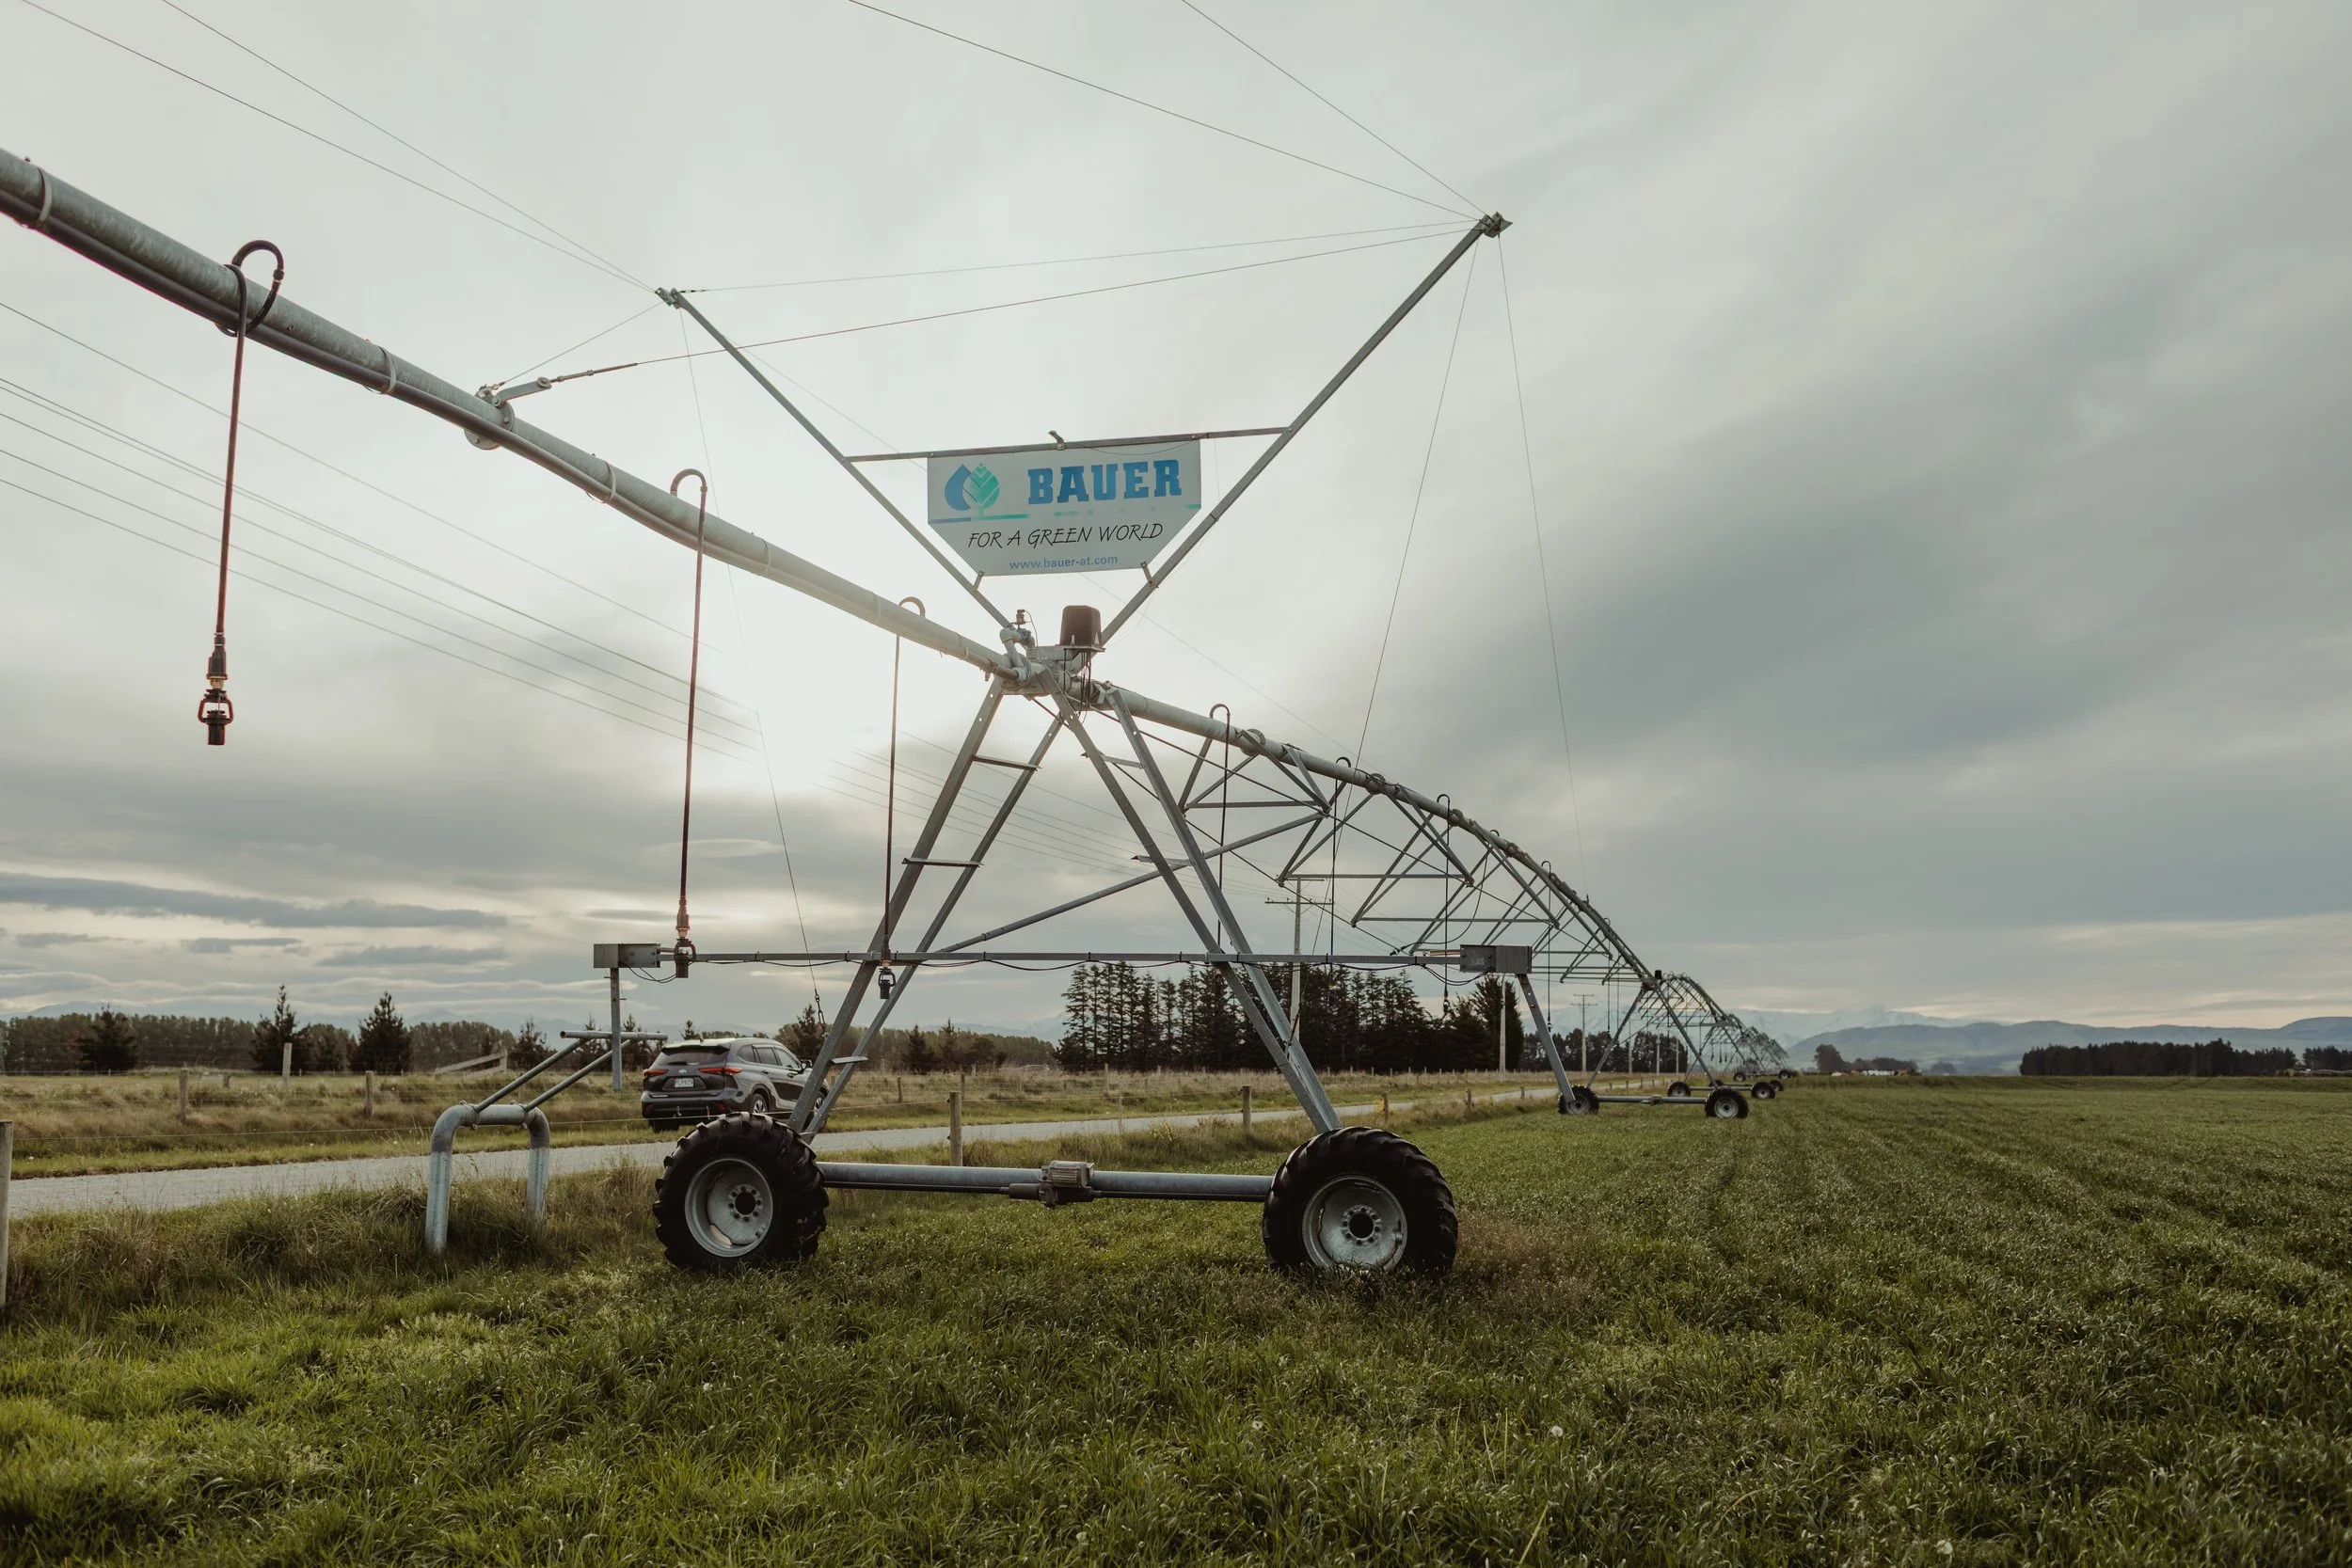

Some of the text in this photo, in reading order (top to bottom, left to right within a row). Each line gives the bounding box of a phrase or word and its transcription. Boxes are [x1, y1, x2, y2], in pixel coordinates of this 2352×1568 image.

[1027, 459, 1182, 505] BAUER
[968, 523, 1164, 548] FOR A GREEN WORLD
[1009, 555, 1118, 570] www.bauer-at.com
